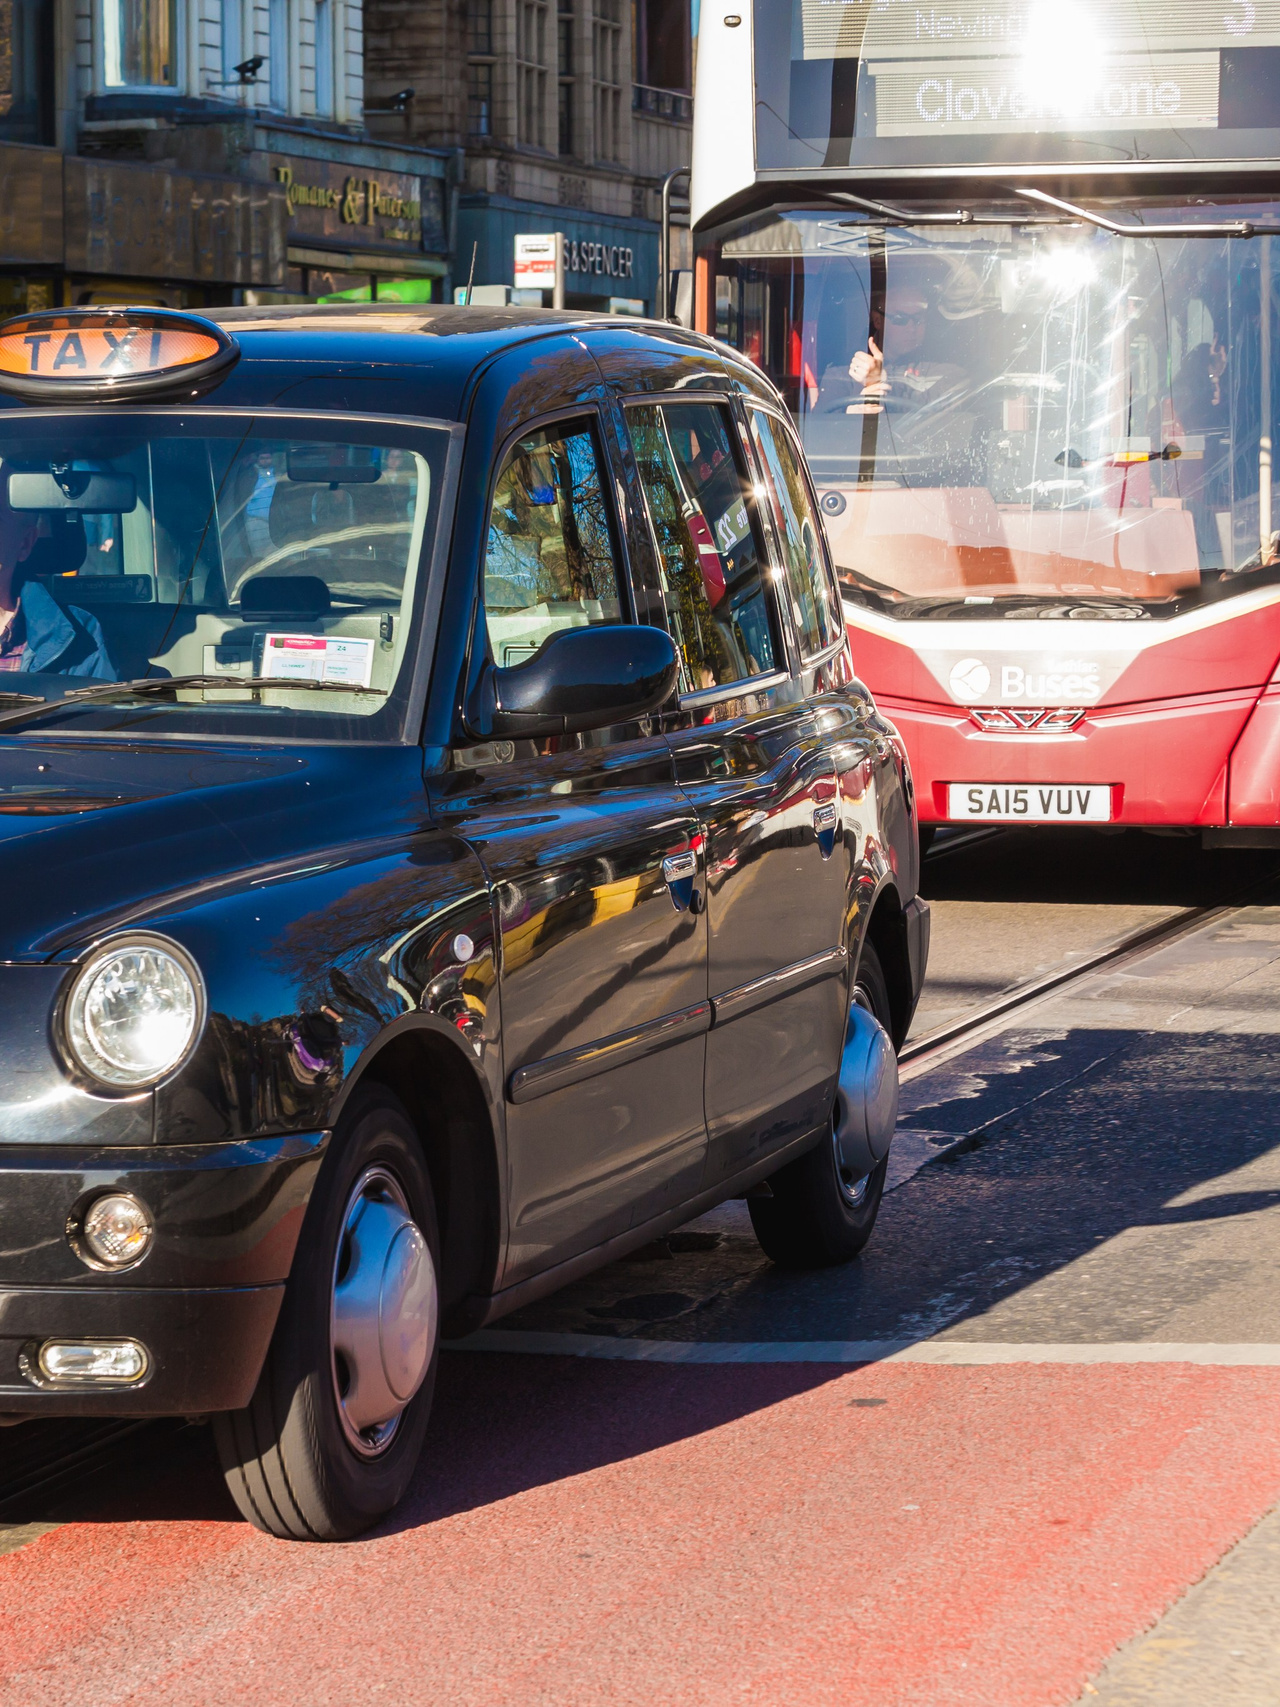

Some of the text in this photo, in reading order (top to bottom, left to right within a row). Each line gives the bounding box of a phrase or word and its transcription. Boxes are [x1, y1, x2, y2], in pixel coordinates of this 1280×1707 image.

[24, 331, 162, 371] TAXI
[1001, 666, 1101, 698] Buses
[967, 789, 1091, 815] SA15 VUV
